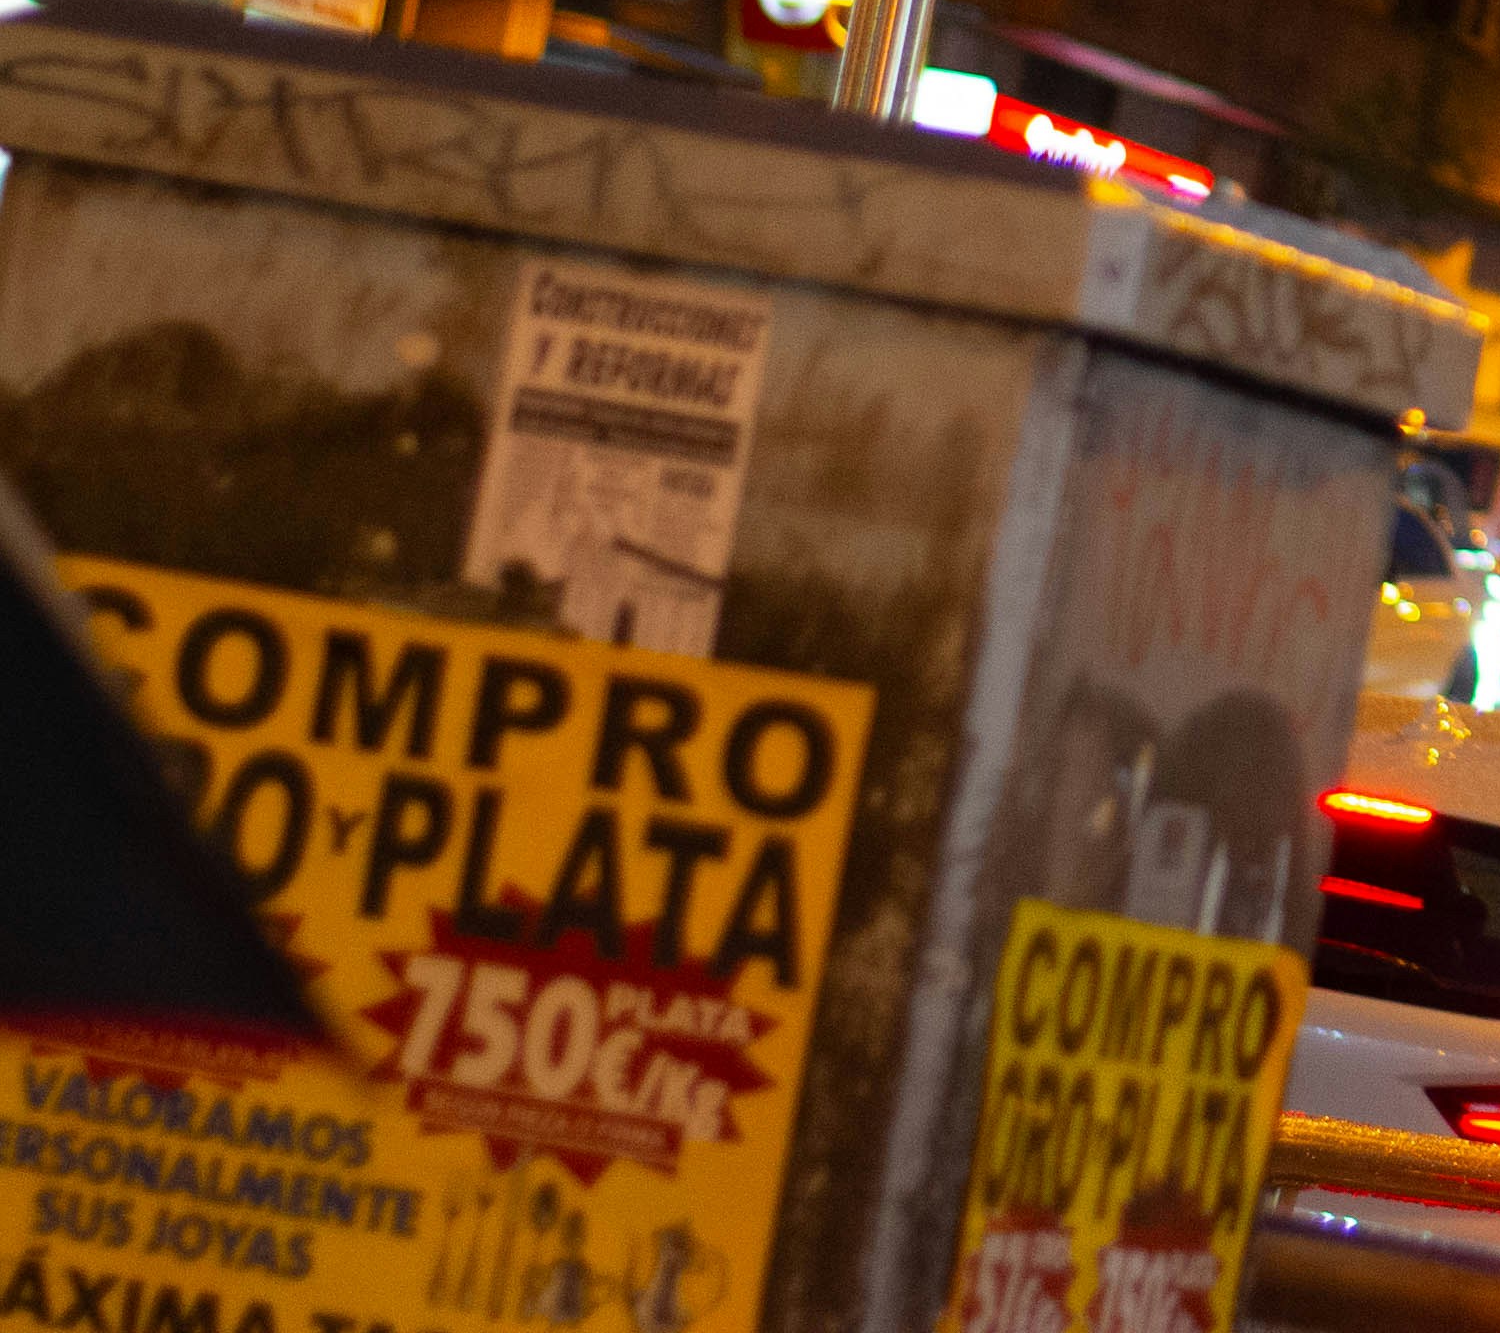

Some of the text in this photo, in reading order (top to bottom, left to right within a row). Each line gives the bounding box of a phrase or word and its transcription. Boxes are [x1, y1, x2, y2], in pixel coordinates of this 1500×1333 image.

[357, 771, 803, 992] PLATA
[401, 954, 600, 1099] 750
[1011, 926, 1283, 1083] COMPRO
[22, 1062, 375, 1169] VALORAMOS
[33, 1188, 316, 1283] SUS JOYAS
